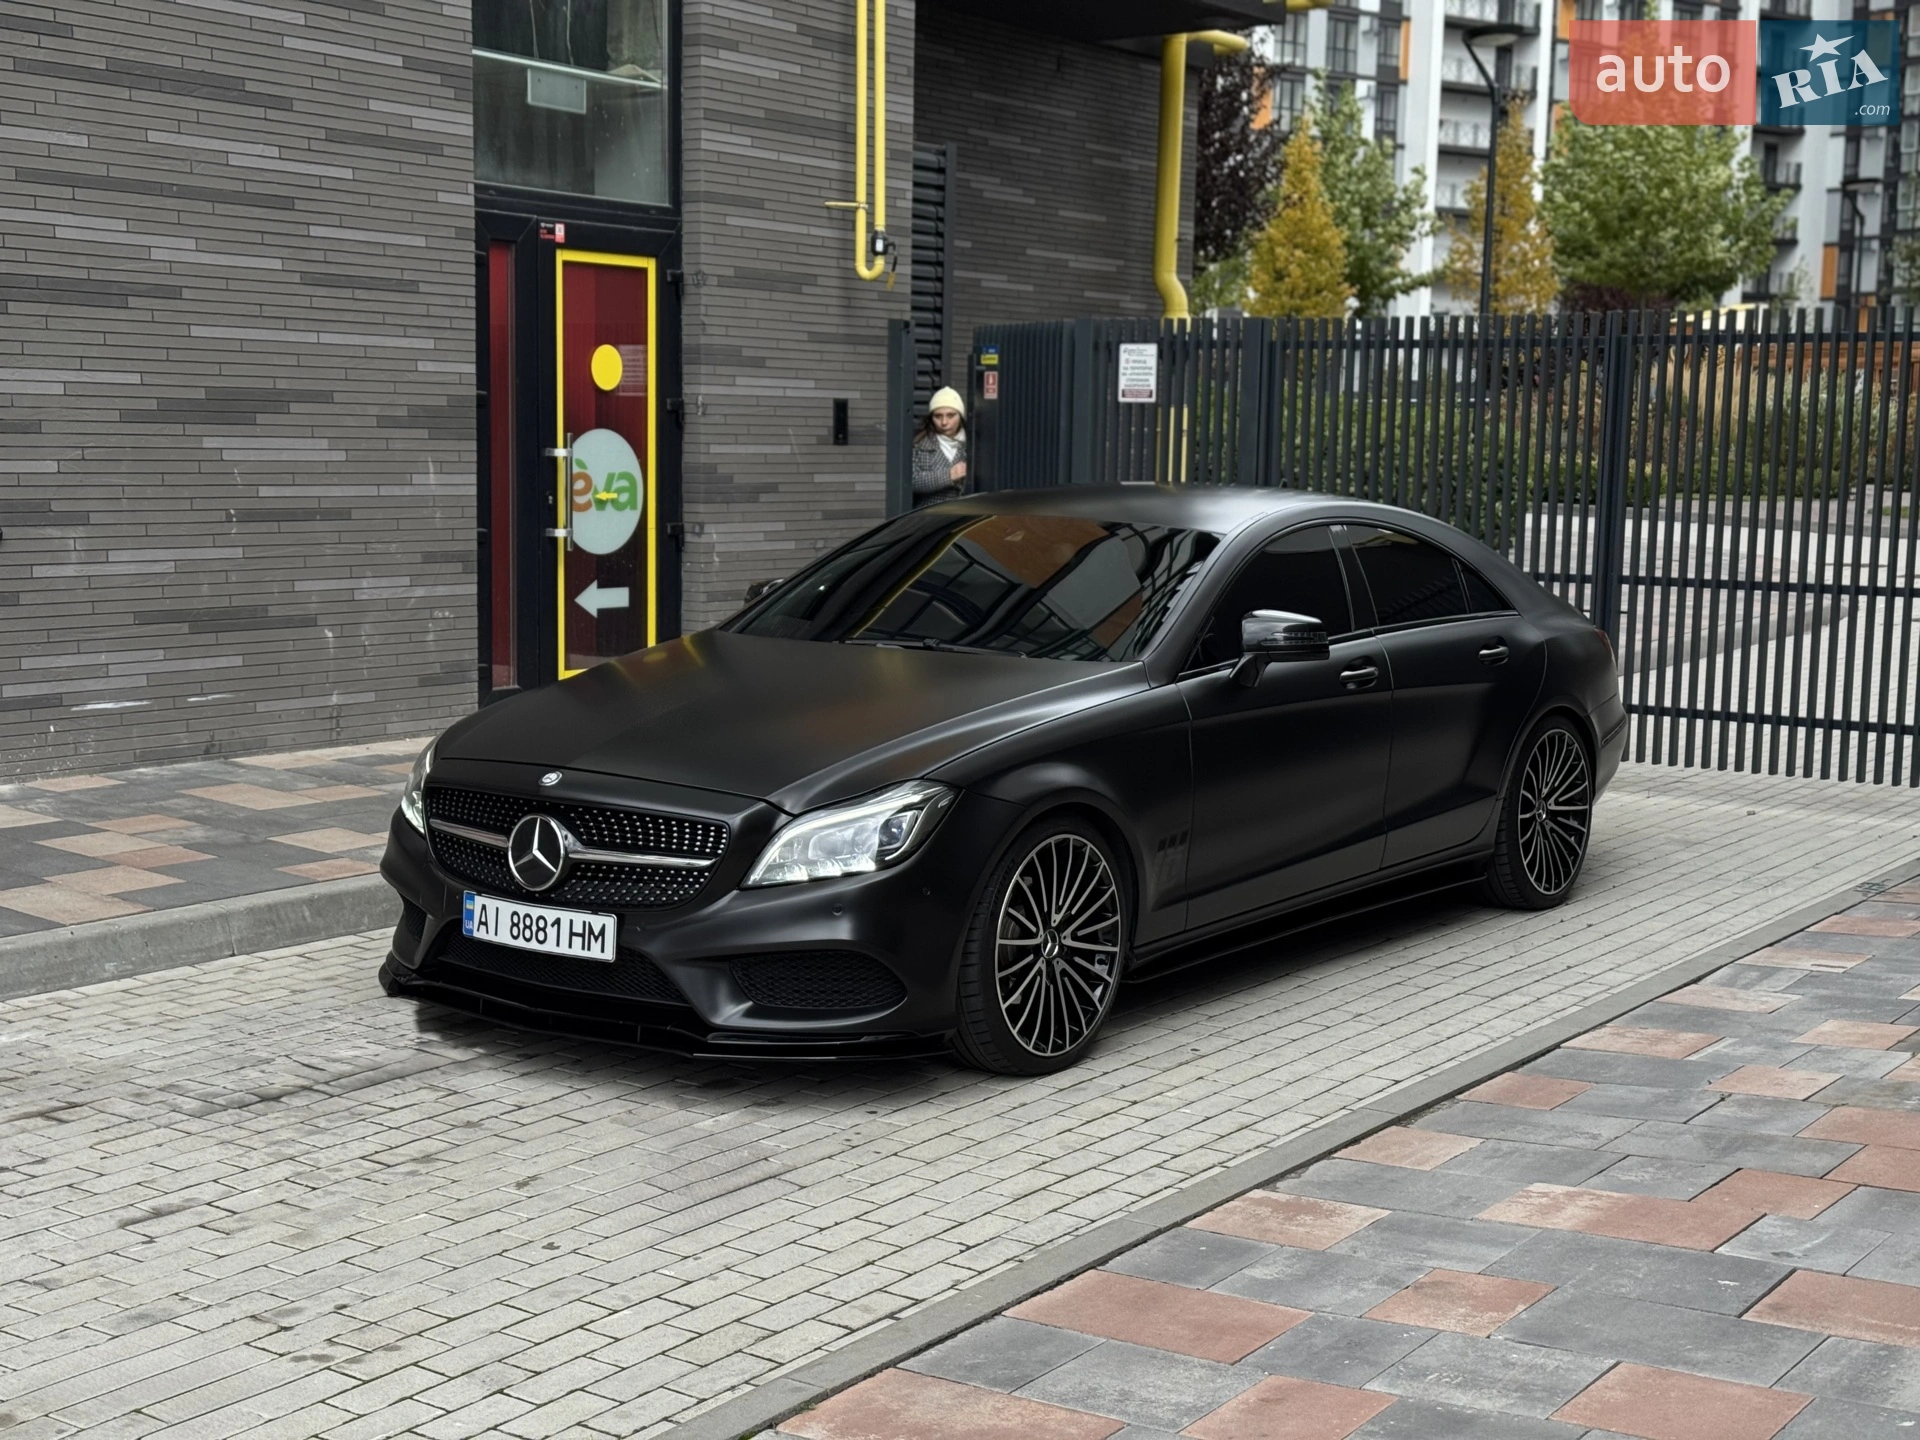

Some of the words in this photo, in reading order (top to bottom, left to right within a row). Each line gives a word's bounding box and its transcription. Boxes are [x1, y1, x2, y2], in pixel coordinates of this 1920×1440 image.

[476, 903, 499, 936] AI
[509, 910, 562, 948] 8881
[568, 918, 606, 954] HM
